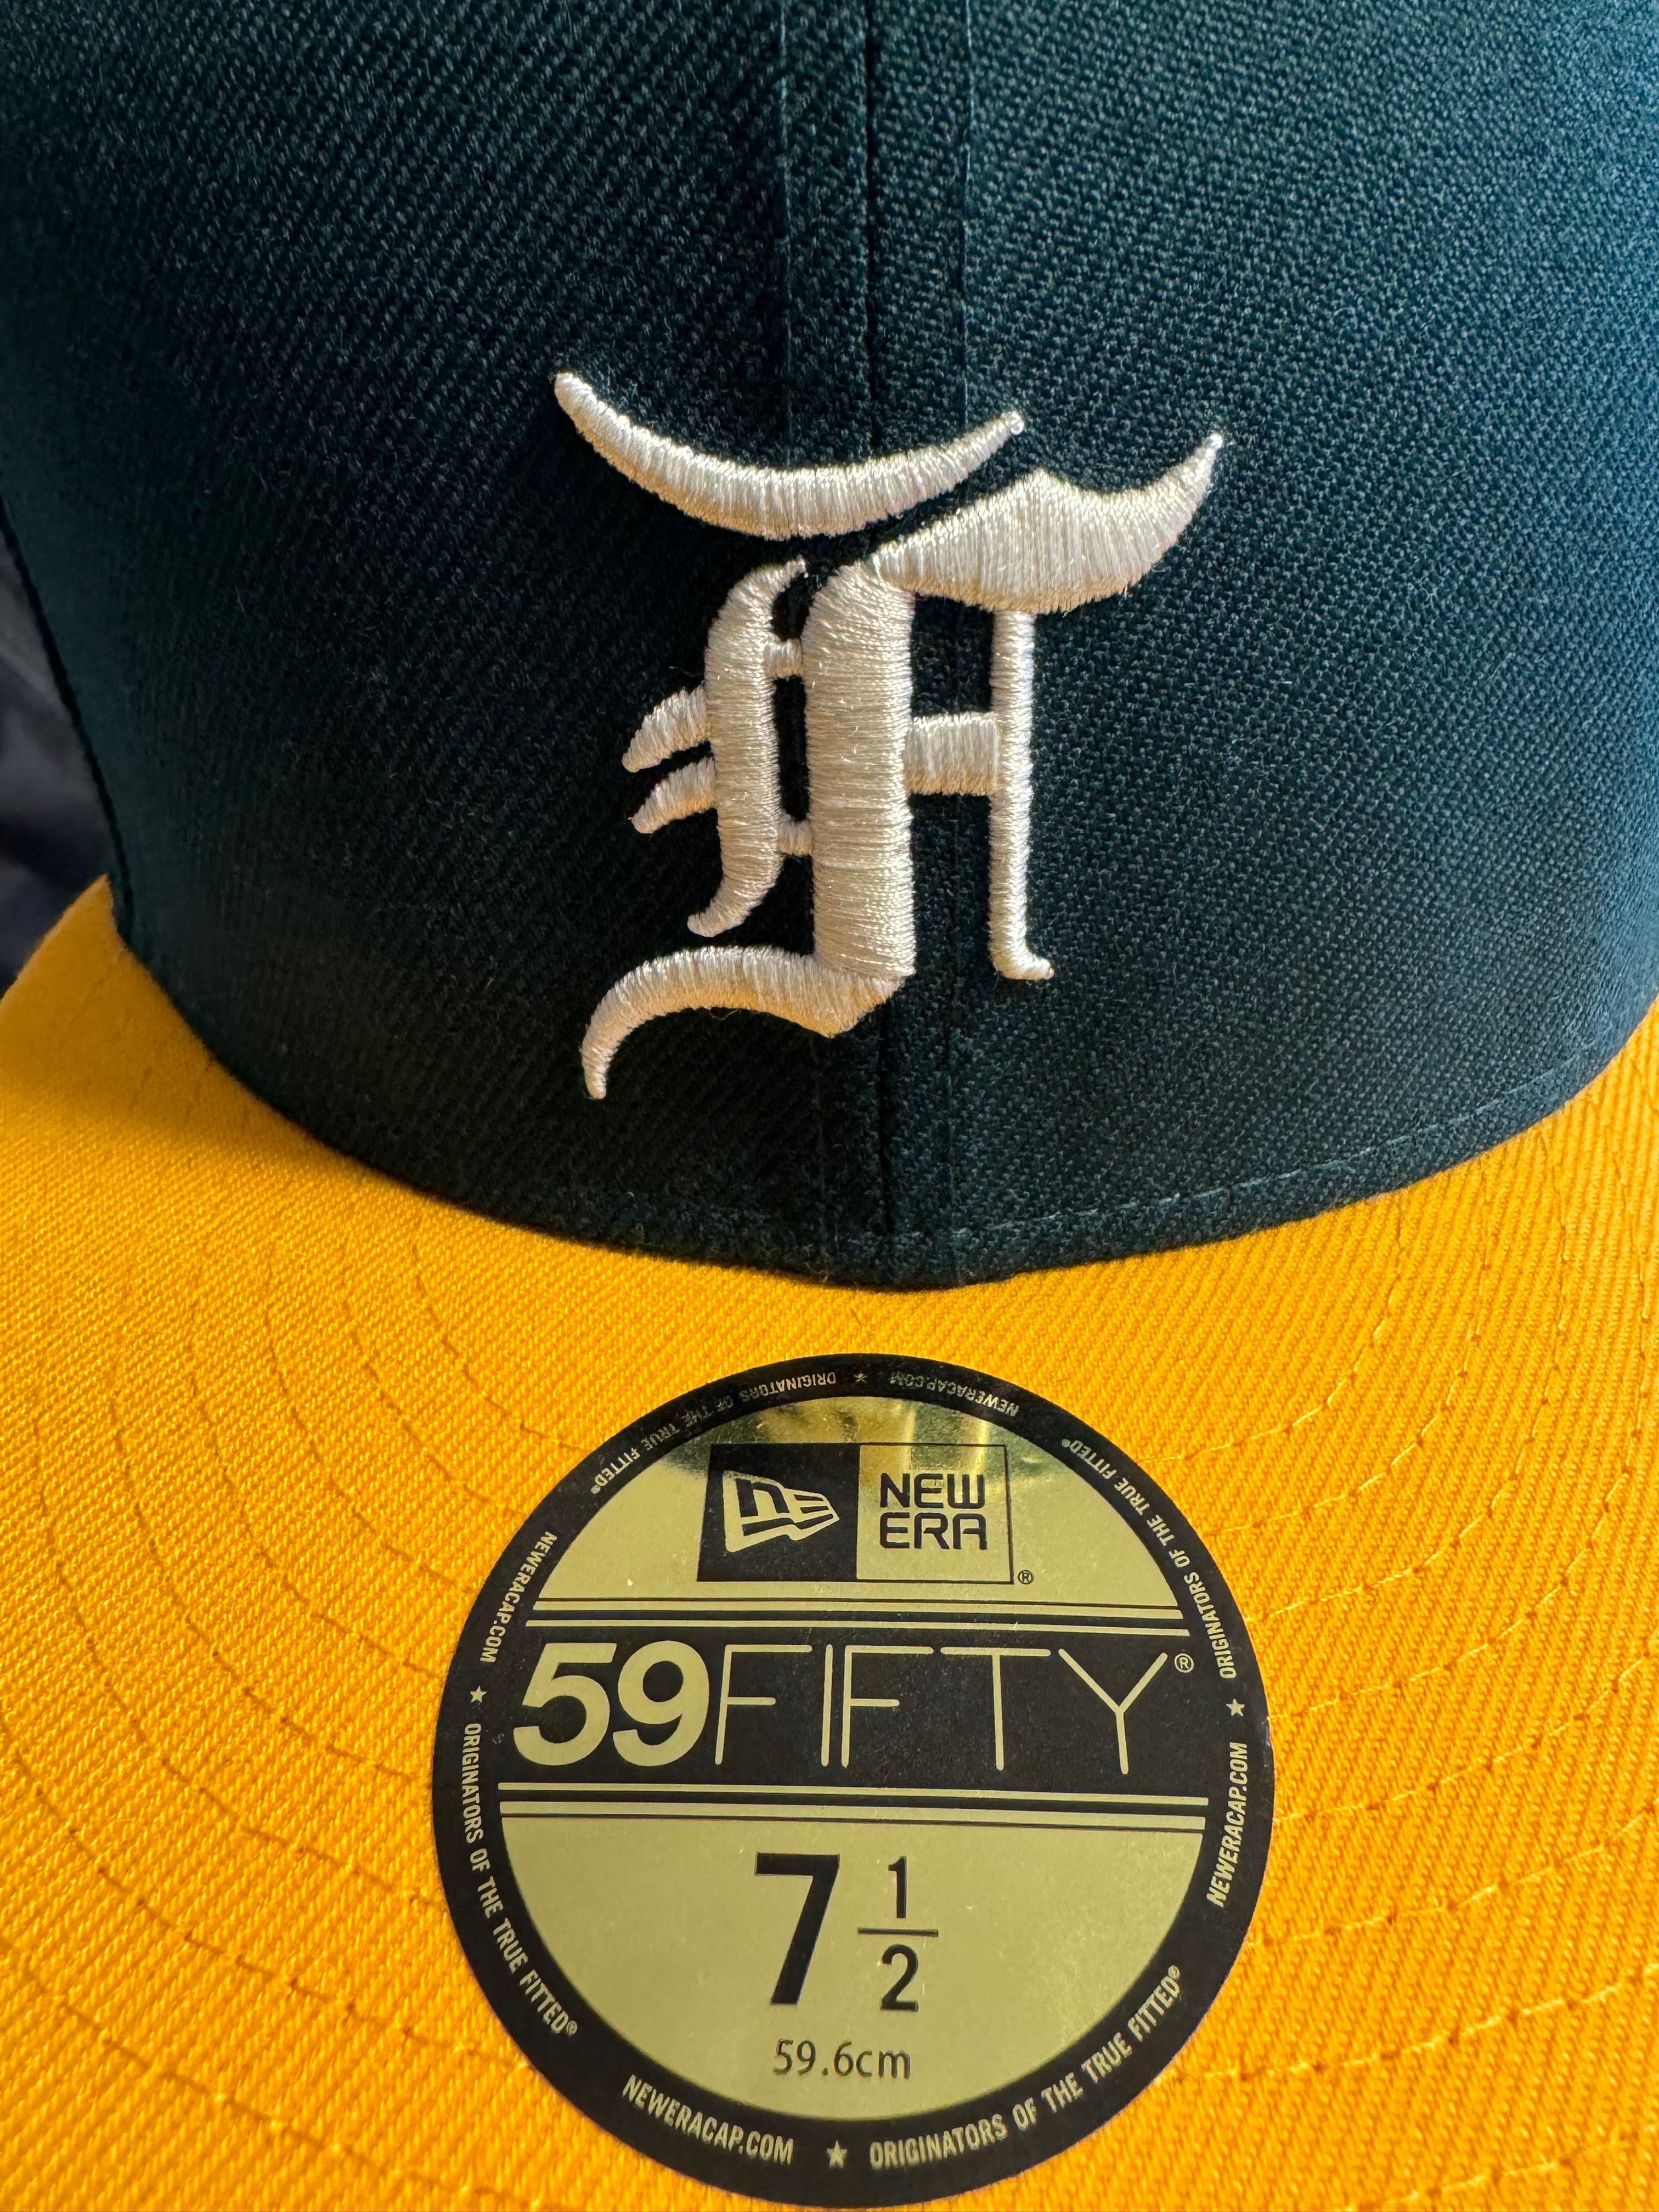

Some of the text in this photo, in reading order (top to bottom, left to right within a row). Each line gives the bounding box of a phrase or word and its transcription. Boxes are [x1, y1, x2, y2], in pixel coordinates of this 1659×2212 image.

[880, 1472, 986, 1509] NEW
[1114, 1477, 1150, 1516] TRUE
[879, 1513, 989, 1550] ERA
[1147, 1515, 1175, 1547] THE
[1169, 1549, 1190, 1568] OF
[480, 1531, 557, 1663] NEWERACAP.COM
[1184, 1571, 1237, 1679] ORIGINATORS
[461, 1723, 483, 1844] ORIGINATORS
[1206, 1742, 1249, 1908] NEWERACAP.COM
[470, 1848, 490, 1871] OF
[477, 1875, 504, 1920] THE
[493, 1917, 529, 1974] TRUE
[754, 1852, 840, 2006] 7
[772, 2039, 912, 2080] 59.6cm
[622, 2074, 794, 2165] NEWERACAP.COM
[870, 2113, 1008, 2170] ORIGINATORS
[1012, 2098, 1038, 2131] OF
[1041, 2072, 1084, 2113] THE
[1081, 2032, 1132, 2084] TRUE
